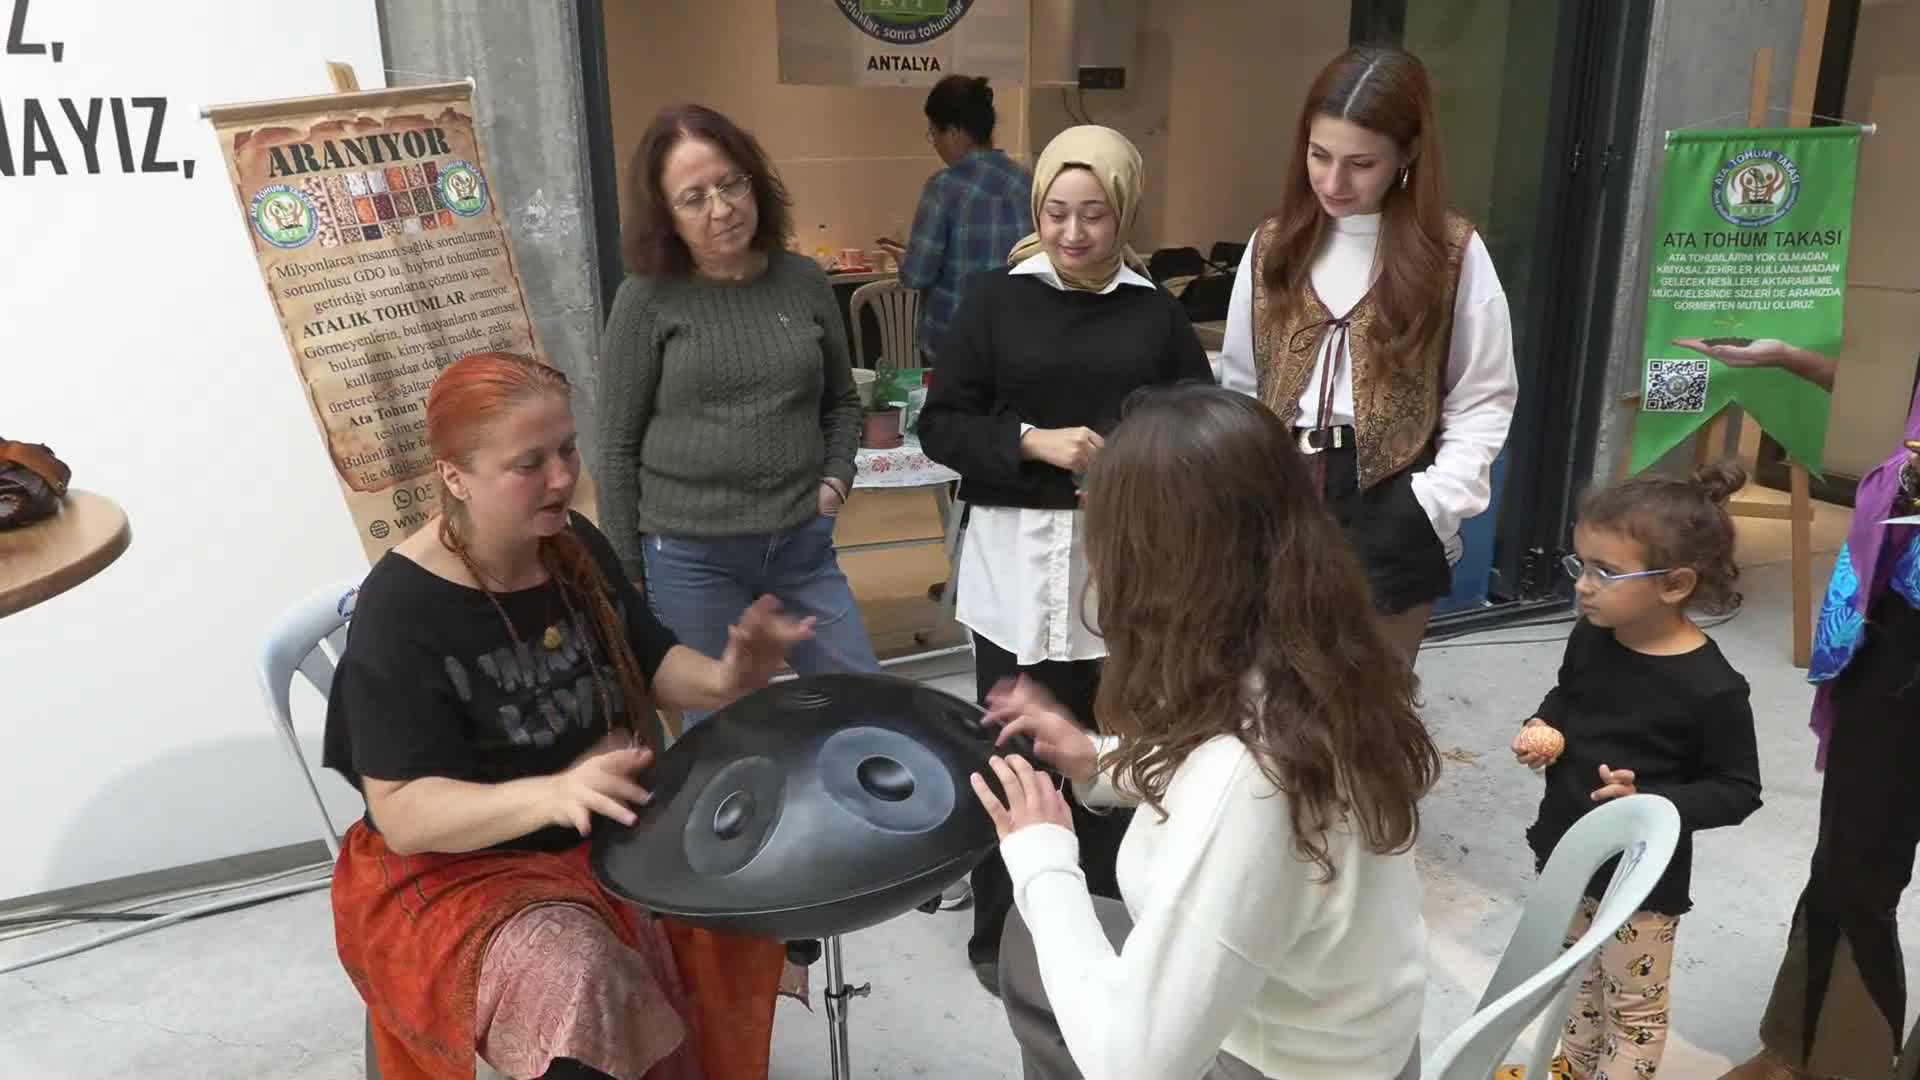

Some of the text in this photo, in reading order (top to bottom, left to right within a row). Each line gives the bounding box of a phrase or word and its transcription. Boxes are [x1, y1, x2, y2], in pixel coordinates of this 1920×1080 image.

[883, 28, 917, 41] sonra
[919, 2, 964, 38] tohumlar
[867, 55, 941, 72] ANTALYA
[269, 128, 451, 177] ARANIYOR
[1714, 149, 1800, 185] ATA TOHUM TAKASI
[255, 184, 286, 201] TOHUM
[1663, 229, 1842, 248] ATA TOHUM TAKASI
[275, 255, 354, 279] Milyonlarca
[401, 239, 434, 256] sağlık
[437, 229, 496, 246] sorunlarının
[1668, 253, 1687, 262] ATA
[1755, 252, 1777, 262] YOK
[1778, 252, 1829, 262] OLMADAN
[283, 276, 352, 297] sorumlusu
[353, 266, 386, 282] GDO
[446, 247, 501, 265] tohumların
[1661, 277, 1706, 286] GELECEK
[313, 288, 368, 314] getirdiği
[369, 280, 426, 300] sorunların
[428, 270, 469, 289] çözümü
[1736, 300, 1772, 310] MUTLU
[1773, 299, 1815, 310] OLURUZ
[1772, 288, 1787, 298] DE
[1788, 287, 1841, 298] ARAMIZDA
[303, 310, 372, 339] ATALIK
[373, 290, 468, 322] TOHUMLAR
[402, 311, 478, 337] bulmayanların
[397, 336, 448, 357] kimyasal
[343, 362, 421, 390] kullanmadan
[421, 352, 452, 371] doğal
[350, 414, 374, 427] Ata
[375, 401, 419, 421] Tohum
[374, 423, 412, 441] teslim
[342, 446, 396, 470] Bulanlar
[398, 440, 416, 454] bir
[360, 471, 379, 485] ile
